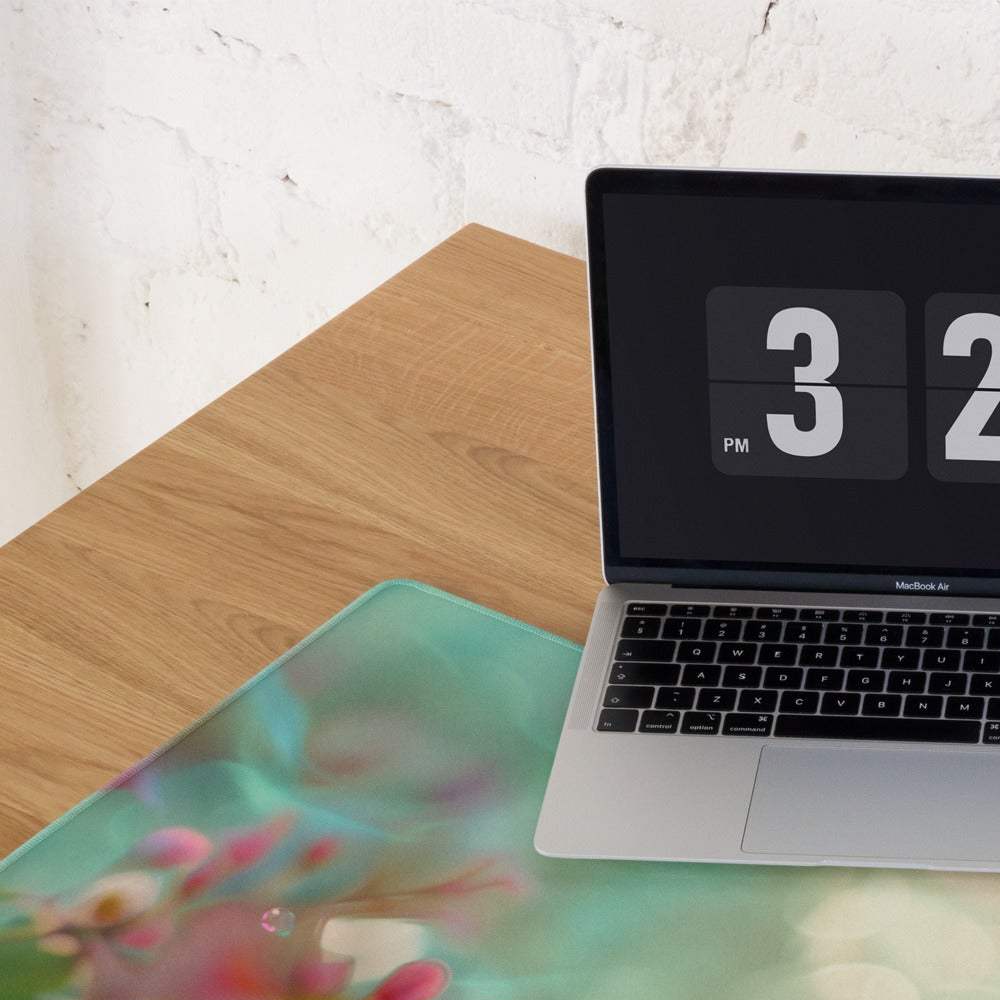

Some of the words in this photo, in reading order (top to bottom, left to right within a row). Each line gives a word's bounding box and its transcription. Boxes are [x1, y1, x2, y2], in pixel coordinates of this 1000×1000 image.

[767, 307, 843, 456] 3
[724, 438, 748, 452] PM
[895, 580, 936, 591] MacBook
[937, 582, 950, 592] Air
